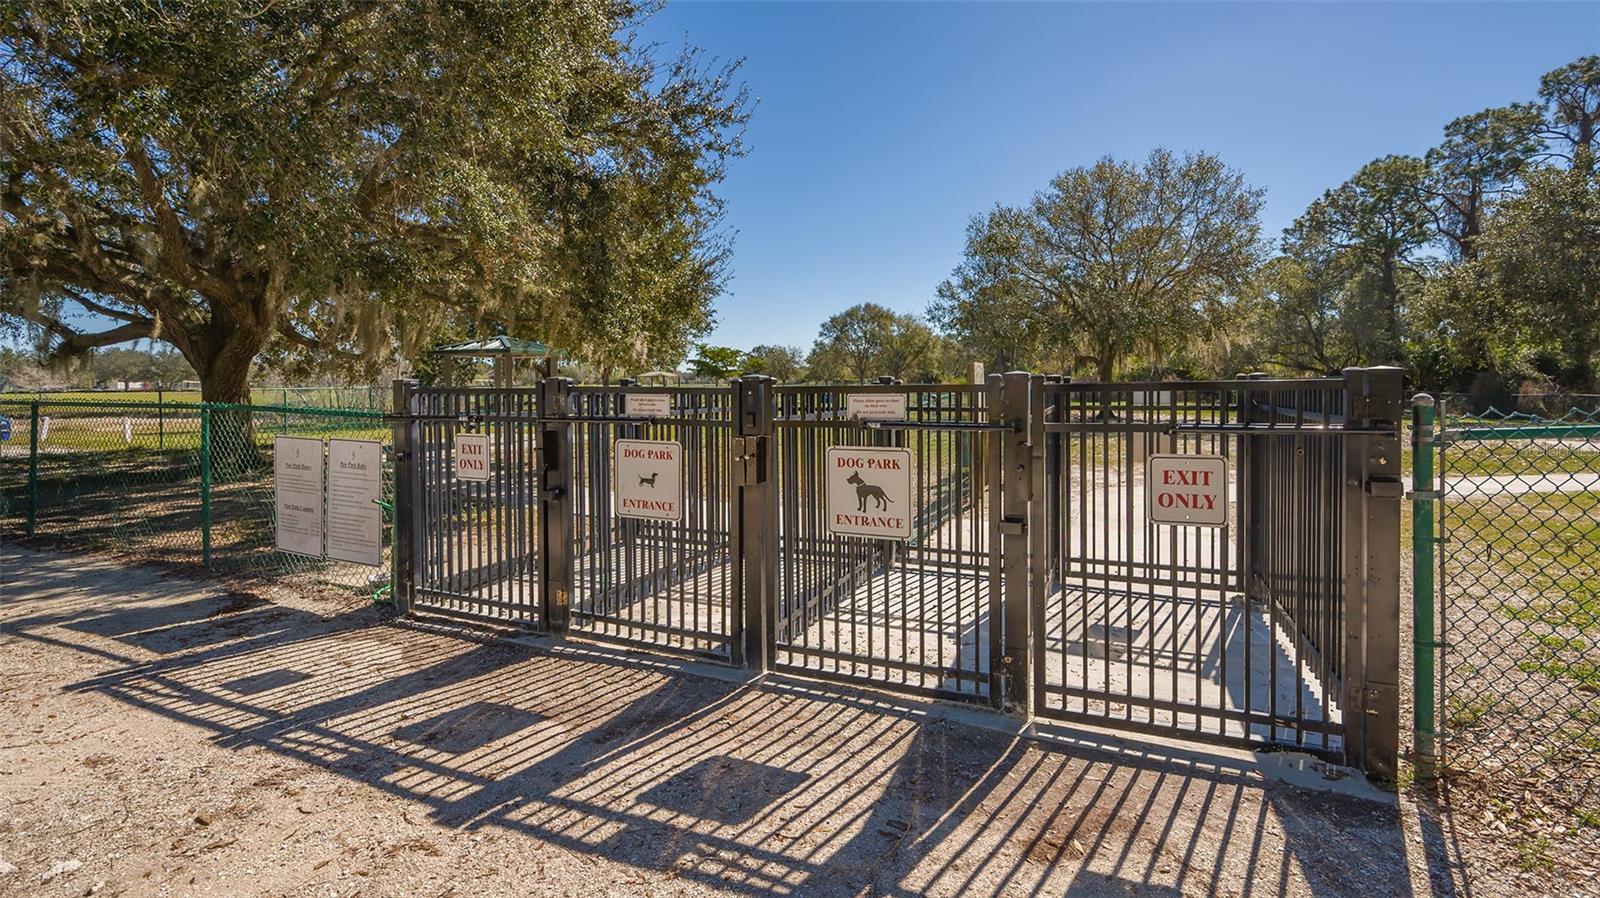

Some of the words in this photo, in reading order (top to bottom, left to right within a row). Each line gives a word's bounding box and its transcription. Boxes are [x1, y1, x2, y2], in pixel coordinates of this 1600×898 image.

[461, 443, 483, 455] EXIT
[624, 448, 646, 460] DOG
[647, 449, 674, 461] PARK
[459, 457, 486, 471] ONLY
[836, 456, 864, 469] DOG
[867, 457, 901, 471] PARK
[1162, 469, 1214, 486] EXIT
[622, 498, 675, 512] ENTRANCE
[1157, 492, 1217, 510] ONLY
[835, 513, 904, 530] ENTRANCE
